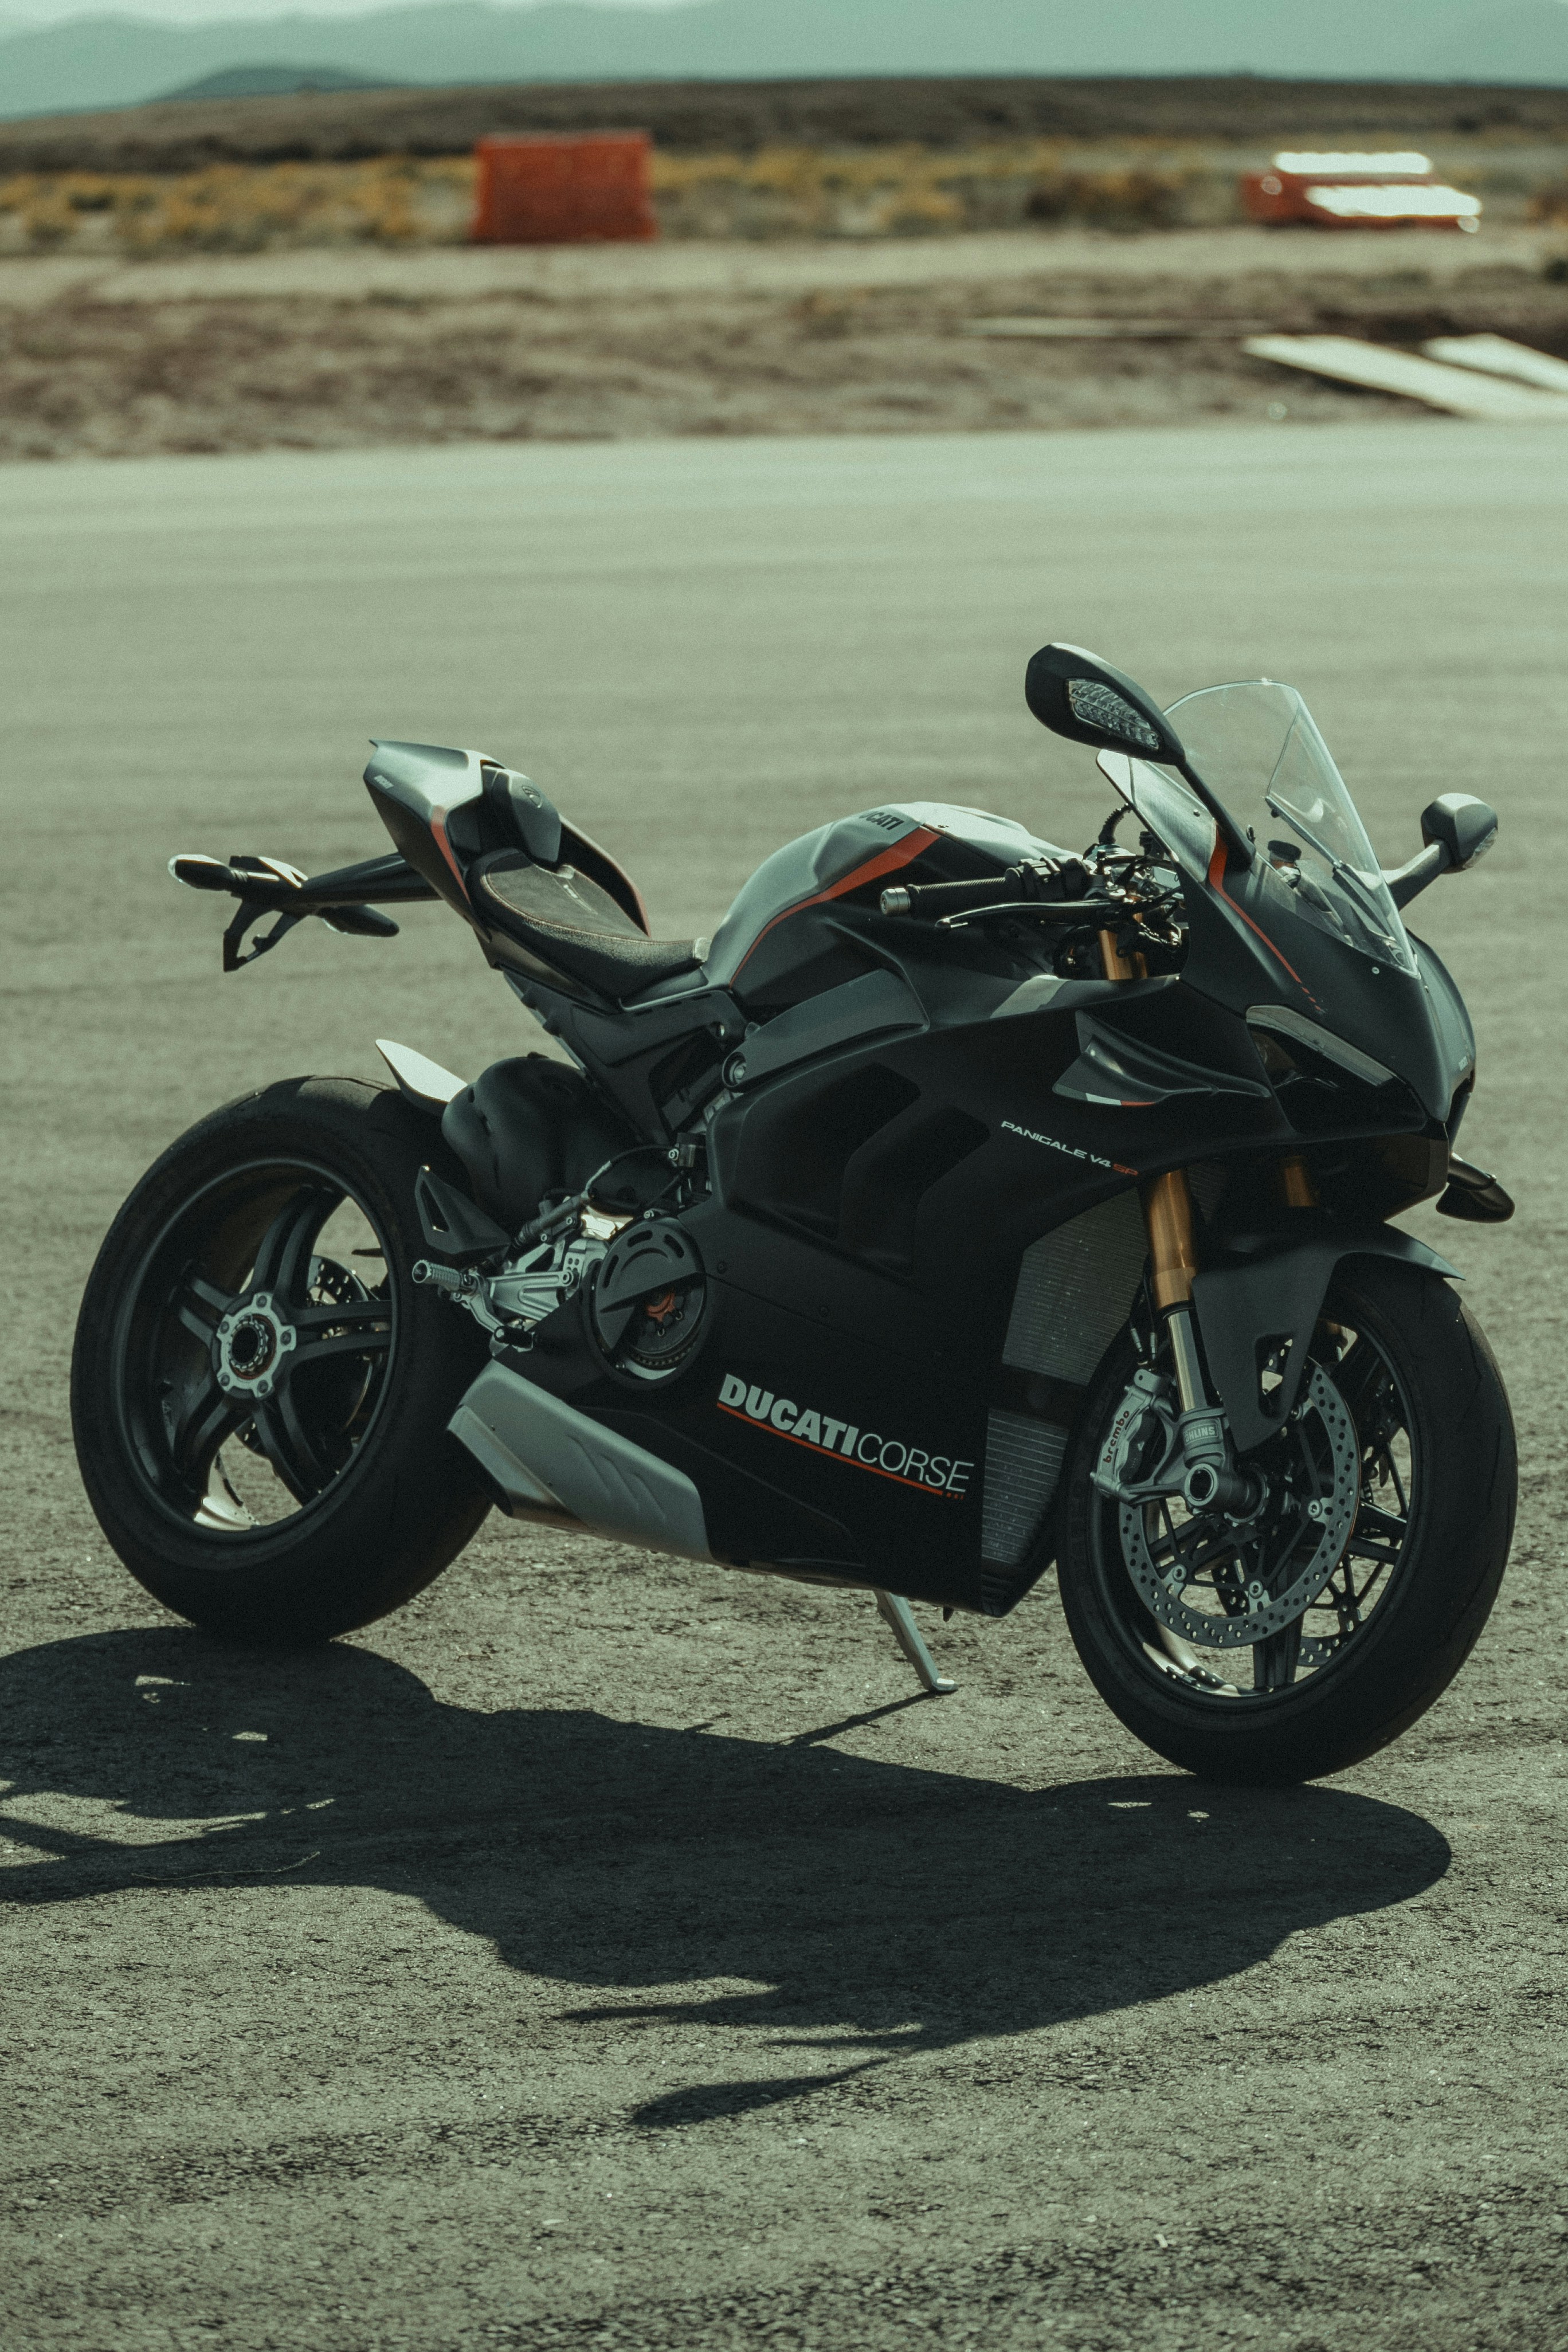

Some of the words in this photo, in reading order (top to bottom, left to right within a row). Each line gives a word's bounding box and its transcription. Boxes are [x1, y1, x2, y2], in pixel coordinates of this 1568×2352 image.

[859, 810, 905, 830] UCATI
[1001, 1120, 1088, 1159] PANIGALE
[1089, 1154, 1111, 1167] V4
[1112, 1163, 1138, 1176] SP
[718, 1373, 859, 1456] DUCATI
[857, 1433, 974, 1493] CORSE
[1103, 1410, 1130, 1463] brembo
